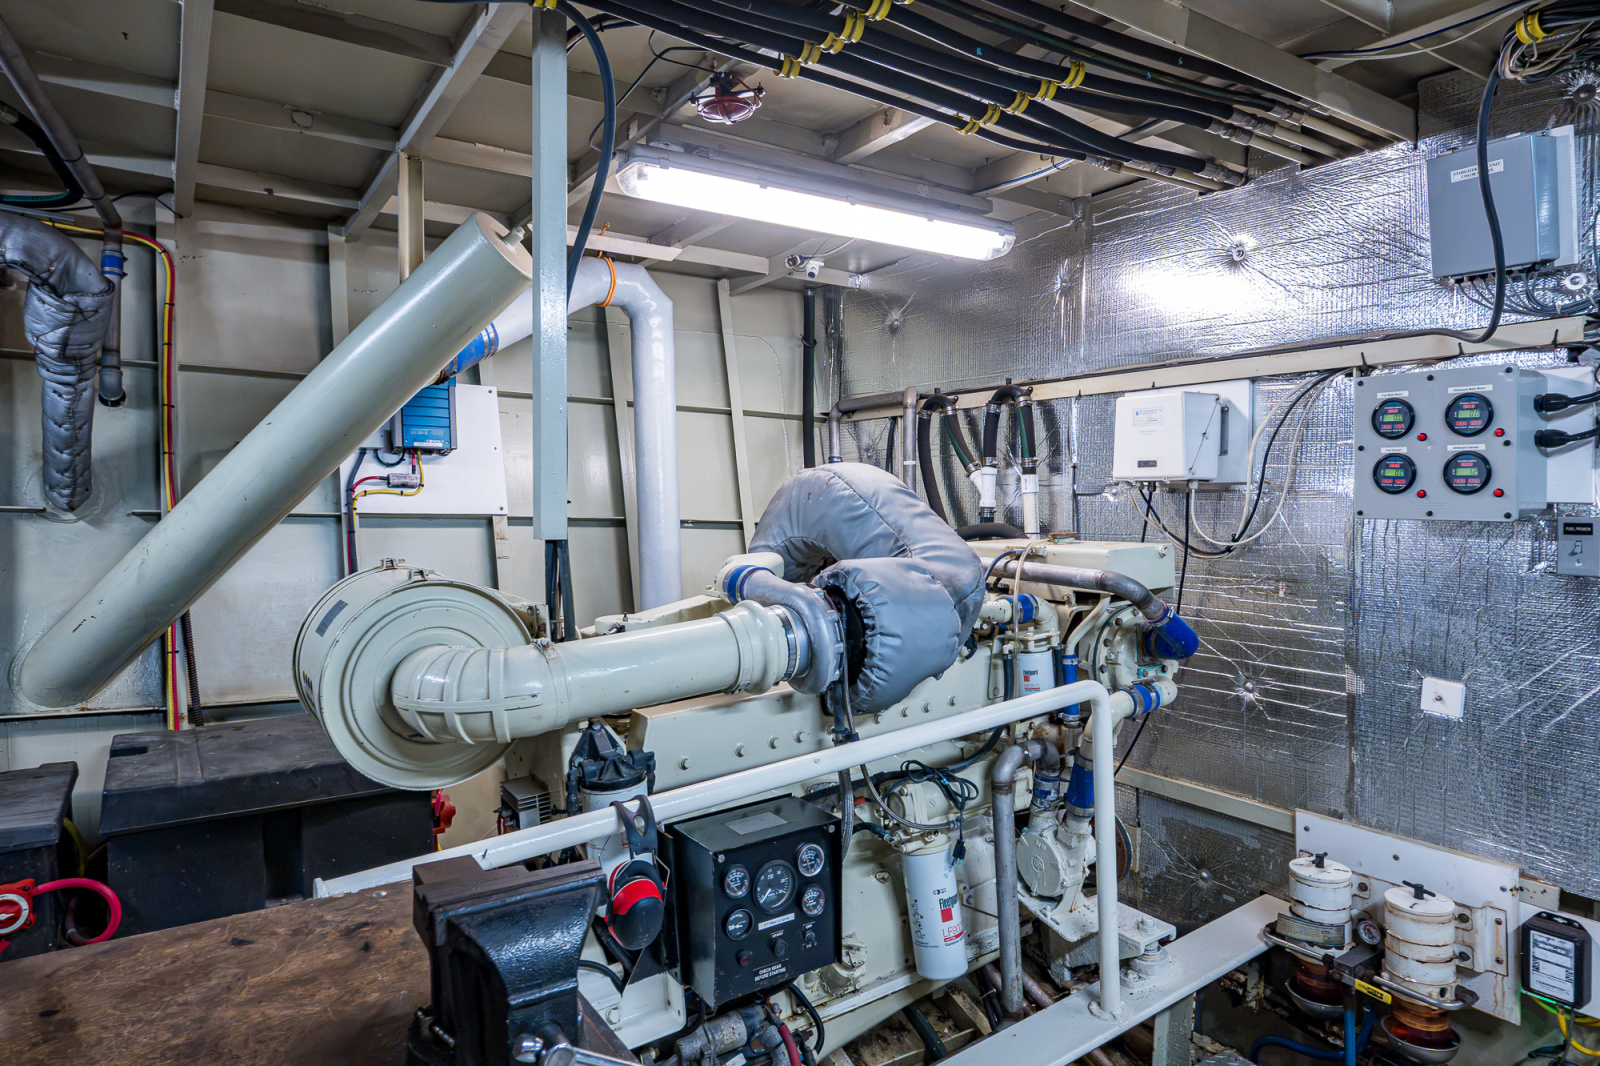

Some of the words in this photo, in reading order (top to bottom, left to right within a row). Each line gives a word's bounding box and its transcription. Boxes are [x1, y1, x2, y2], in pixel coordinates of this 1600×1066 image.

[754, 972, 769, 982] BEFORE
[769, 966, 787, 977] STARTING
[759, 967, 772, 975] CHECK
